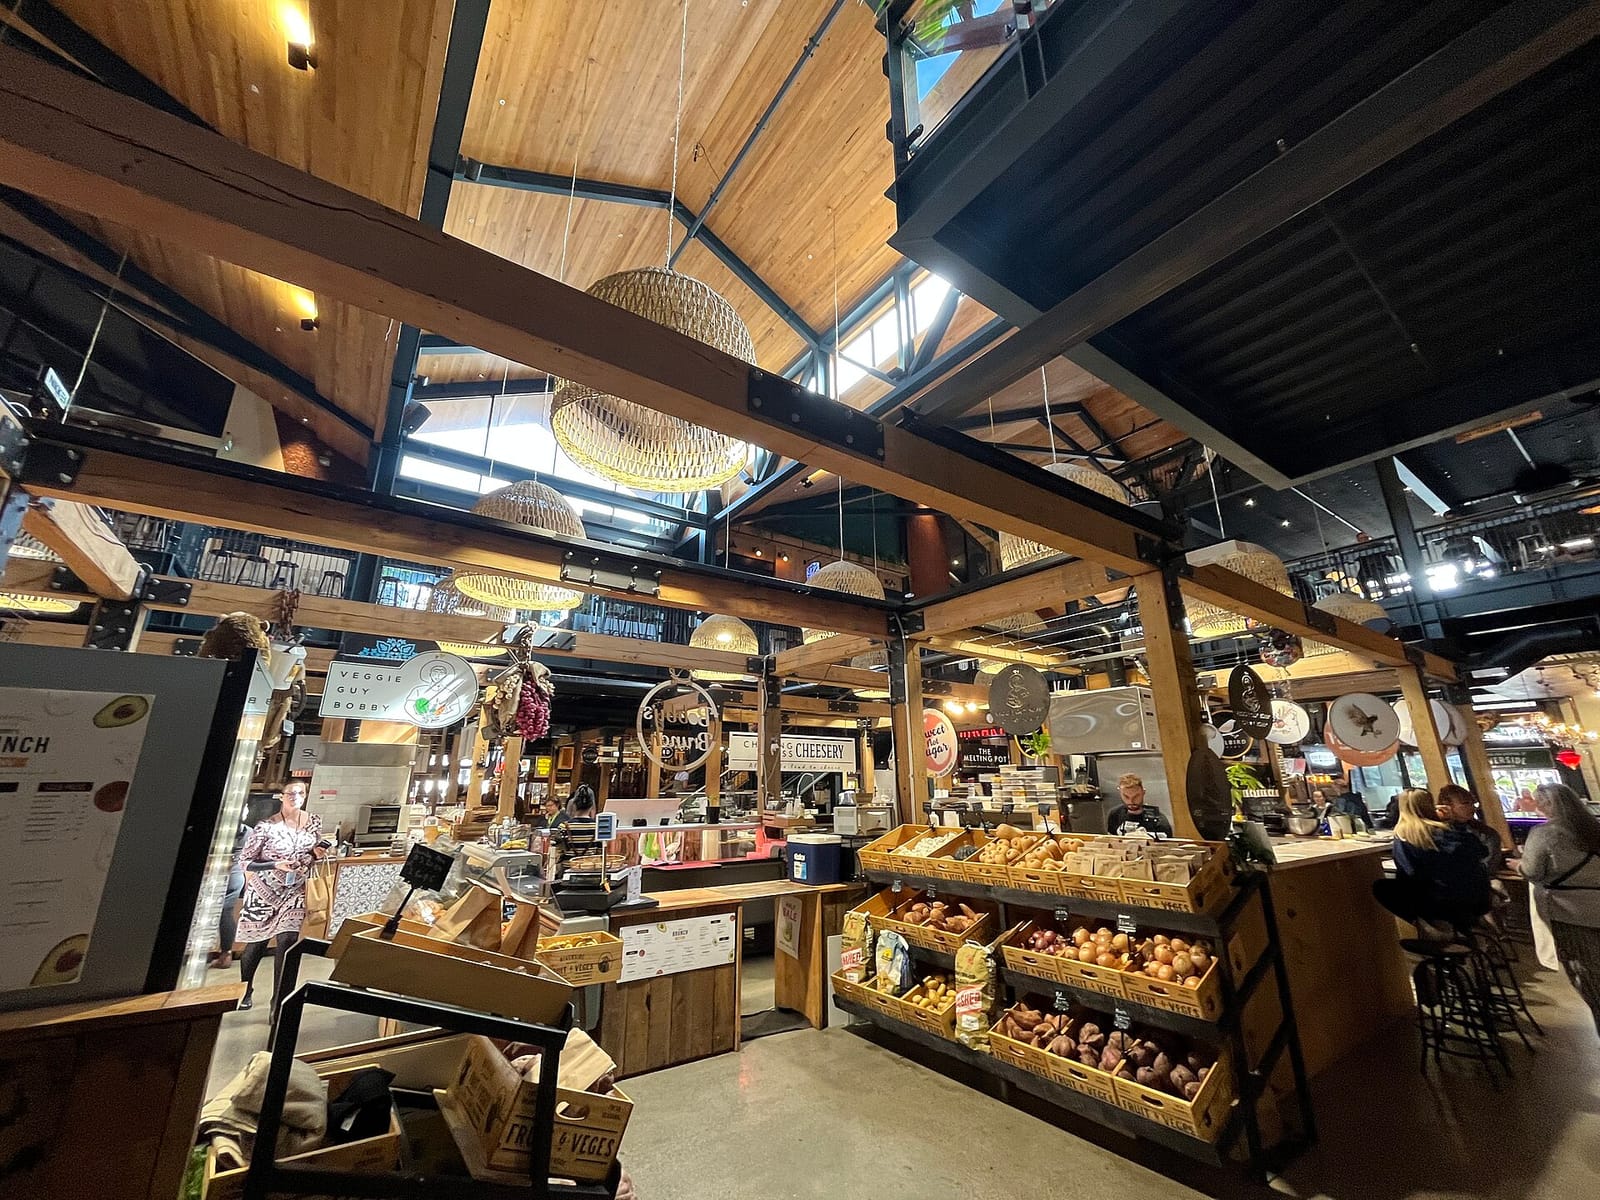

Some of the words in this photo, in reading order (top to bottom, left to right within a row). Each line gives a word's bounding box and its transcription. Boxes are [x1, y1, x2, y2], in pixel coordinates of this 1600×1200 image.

[340, 671, 402, 683] VEGGIE
[337, 686, 369, 695] GUY
[333, 701, 390, 712] BOBBY
[924, 725, 945, 739] weet
[0, 735, 50, 754] NCH
[795, 742, 844, 759] CHEESERY
[925, 744, 949, 759] ugar
[963, 752, 993, 763] MELTING
[994, 755, 1007, 763] POT
[978, 748, 991, 756] THE
[1161, 901, 1190, 913] VEGES
[1037, 969, 1059, 982] VEGES
[1096, 983, 1123, 998] VEGES
[1130, 992, 1157, 1007] FRUIT
[1166, 1002, 1200, 1018] VEGES
[1122, 1099, 1149, 1118] FRUIT
[1160, 1114, 1197, 1137] VEGES
[505, 1123, 534, 1146] FRU
[571, 1133, 615, 1157] VEGES
